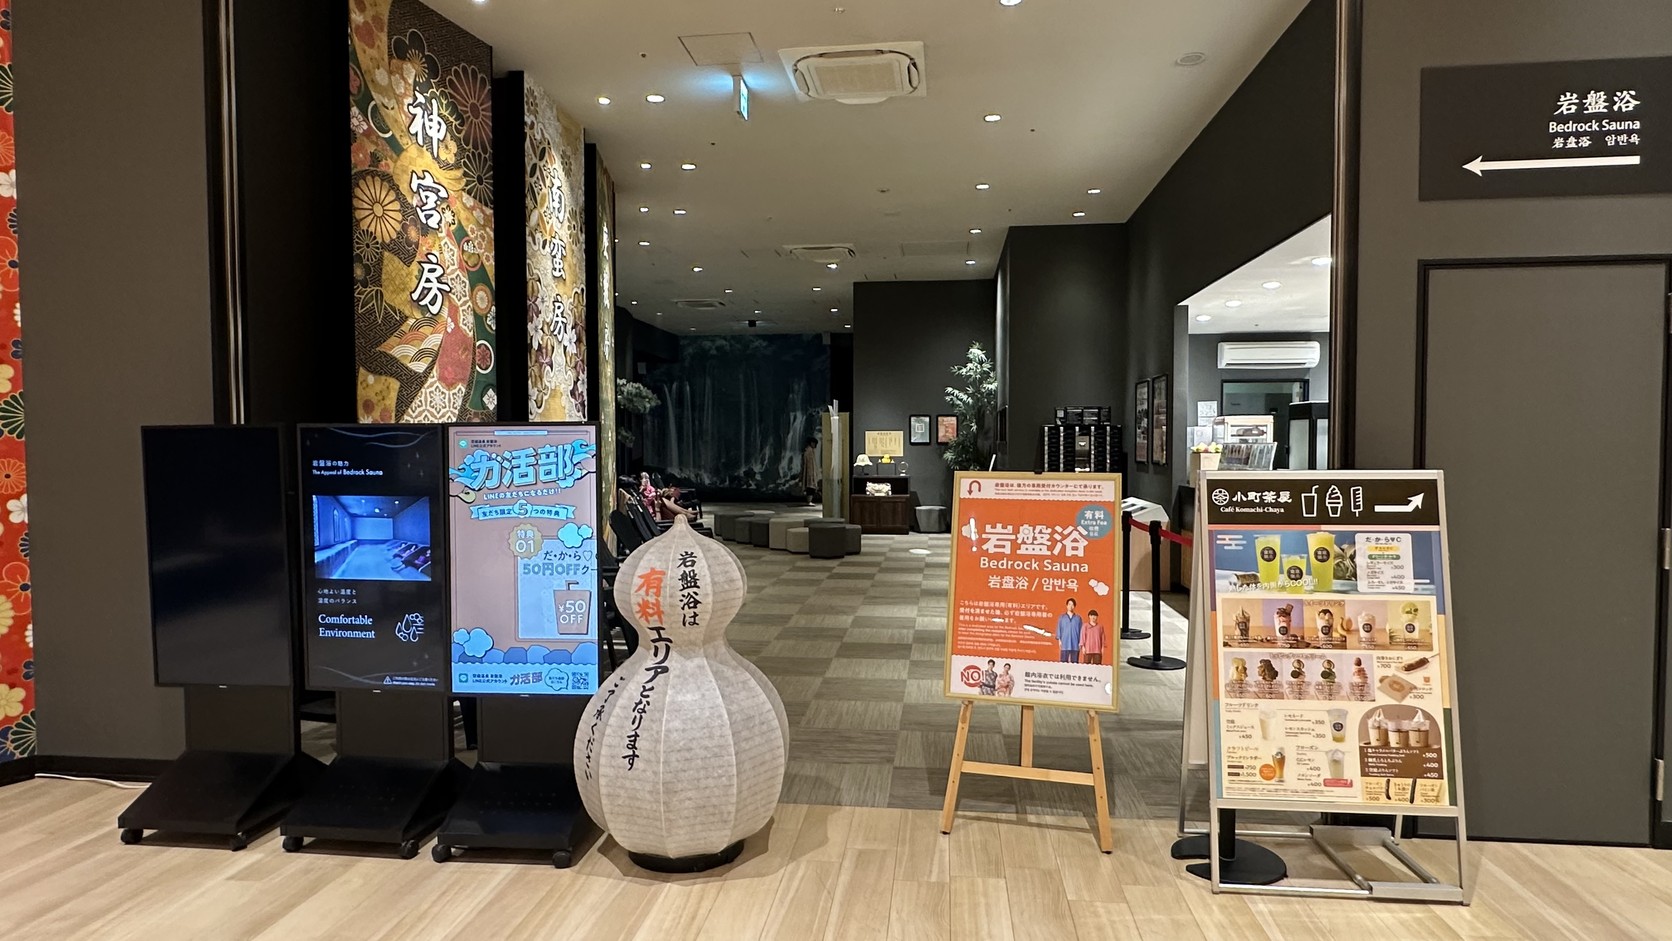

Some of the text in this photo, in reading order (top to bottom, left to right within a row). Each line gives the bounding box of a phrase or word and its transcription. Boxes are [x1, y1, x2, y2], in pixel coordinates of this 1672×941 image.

[1553, 90, 1641, 115] 岩盤浴
[1549, 119, 1641, 133] Bedrock Sauna
[1604, 133, 1641, 146] 암반욕
[407, 88, 451, 315] 神宮房
[1232, 491, 1292, 503] 小町茶屋
[1084, 510, 1104, 520] 有料
[516, 530, 534, 539] 特典
[981, 523, 1089, 558] 岩盤浴
[515, 540, 534, 553] 01
[980, 557, 1089, 573] Bedrock Sauna
[677, 551, 702, 627] 岩盤浴は
[988, 575, 1029, 590] 岩盘浴
[1041, 577, 1079, 592] 암반욕
[558, 600, 586, 613] ¥50
[318, 613, 373, 625] Comfortable
[560, 614, 583, 624] OFF
[319, 627, 375, 639] Environment
[960, 670, 985, 683] NO!
